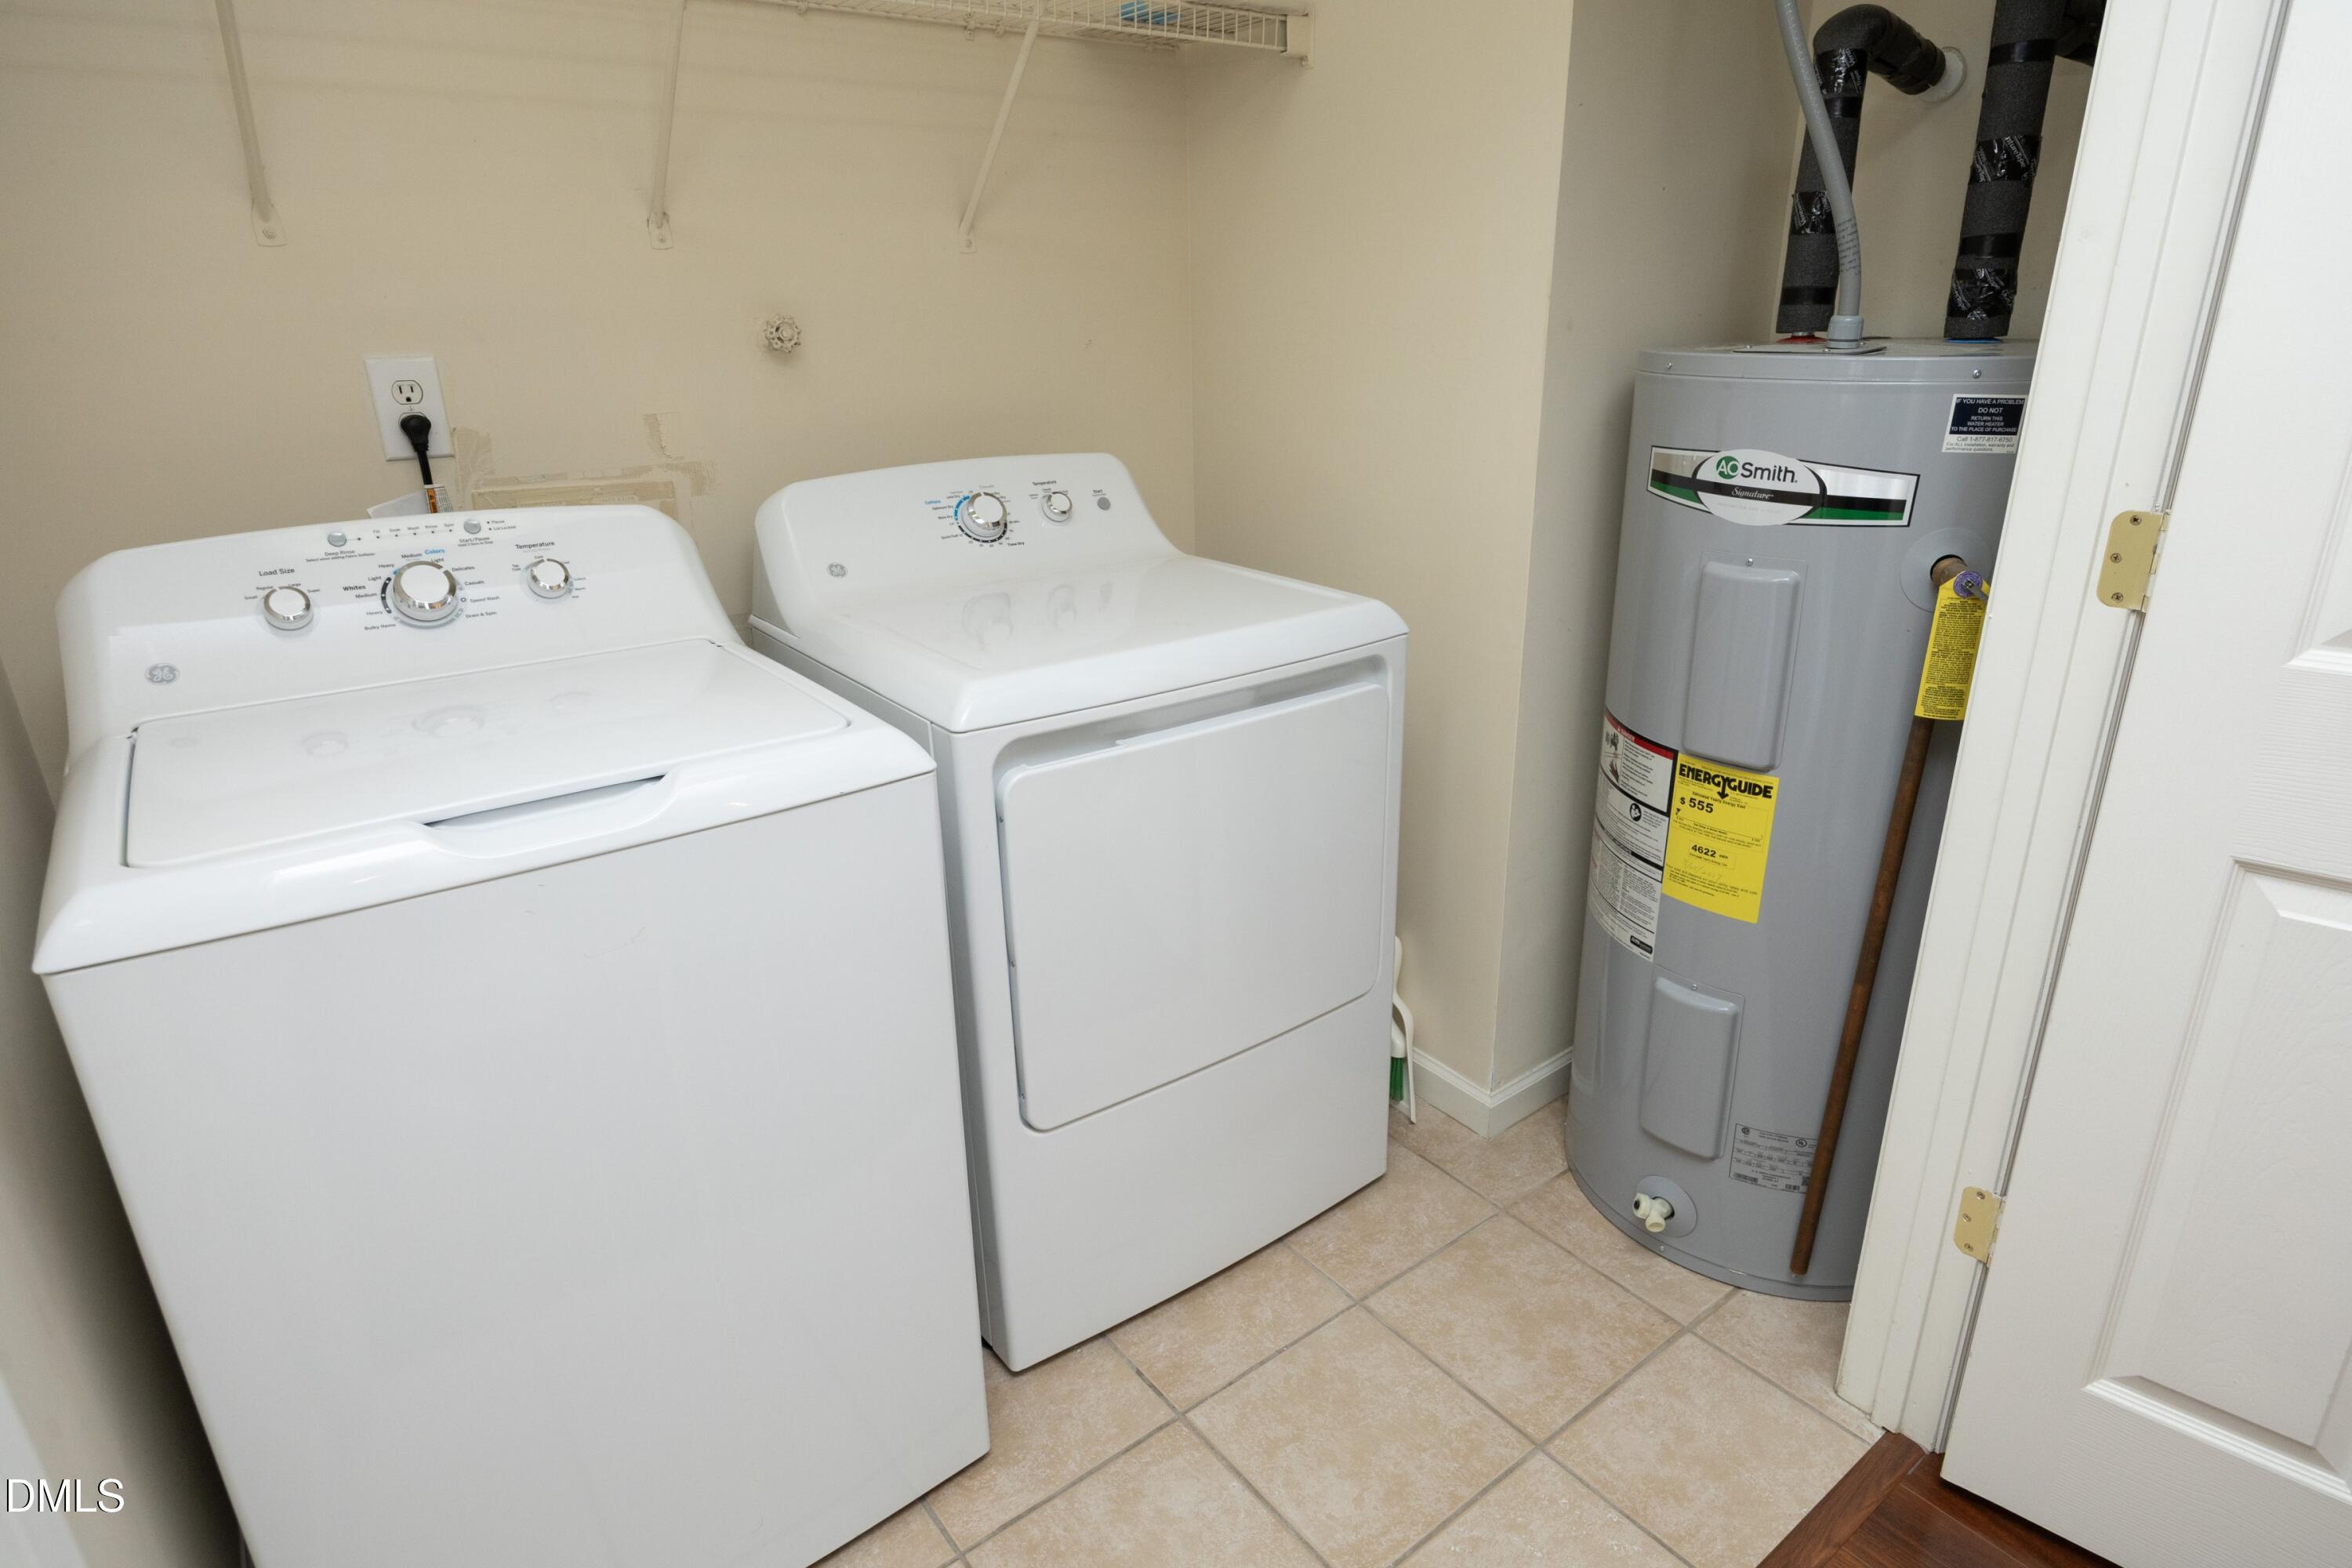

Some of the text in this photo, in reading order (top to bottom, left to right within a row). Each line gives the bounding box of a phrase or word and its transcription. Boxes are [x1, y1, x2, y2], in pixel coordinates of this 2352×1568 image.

[1731, 487, 1773, 500] Signature
[515, 541, 556, 550] Temperature
[1679, 763, 1773, 799] ENERGYGUIDE
[1680, 797, 1714, 813] $ 555
[1691, 844, 1716, 858] 4622
